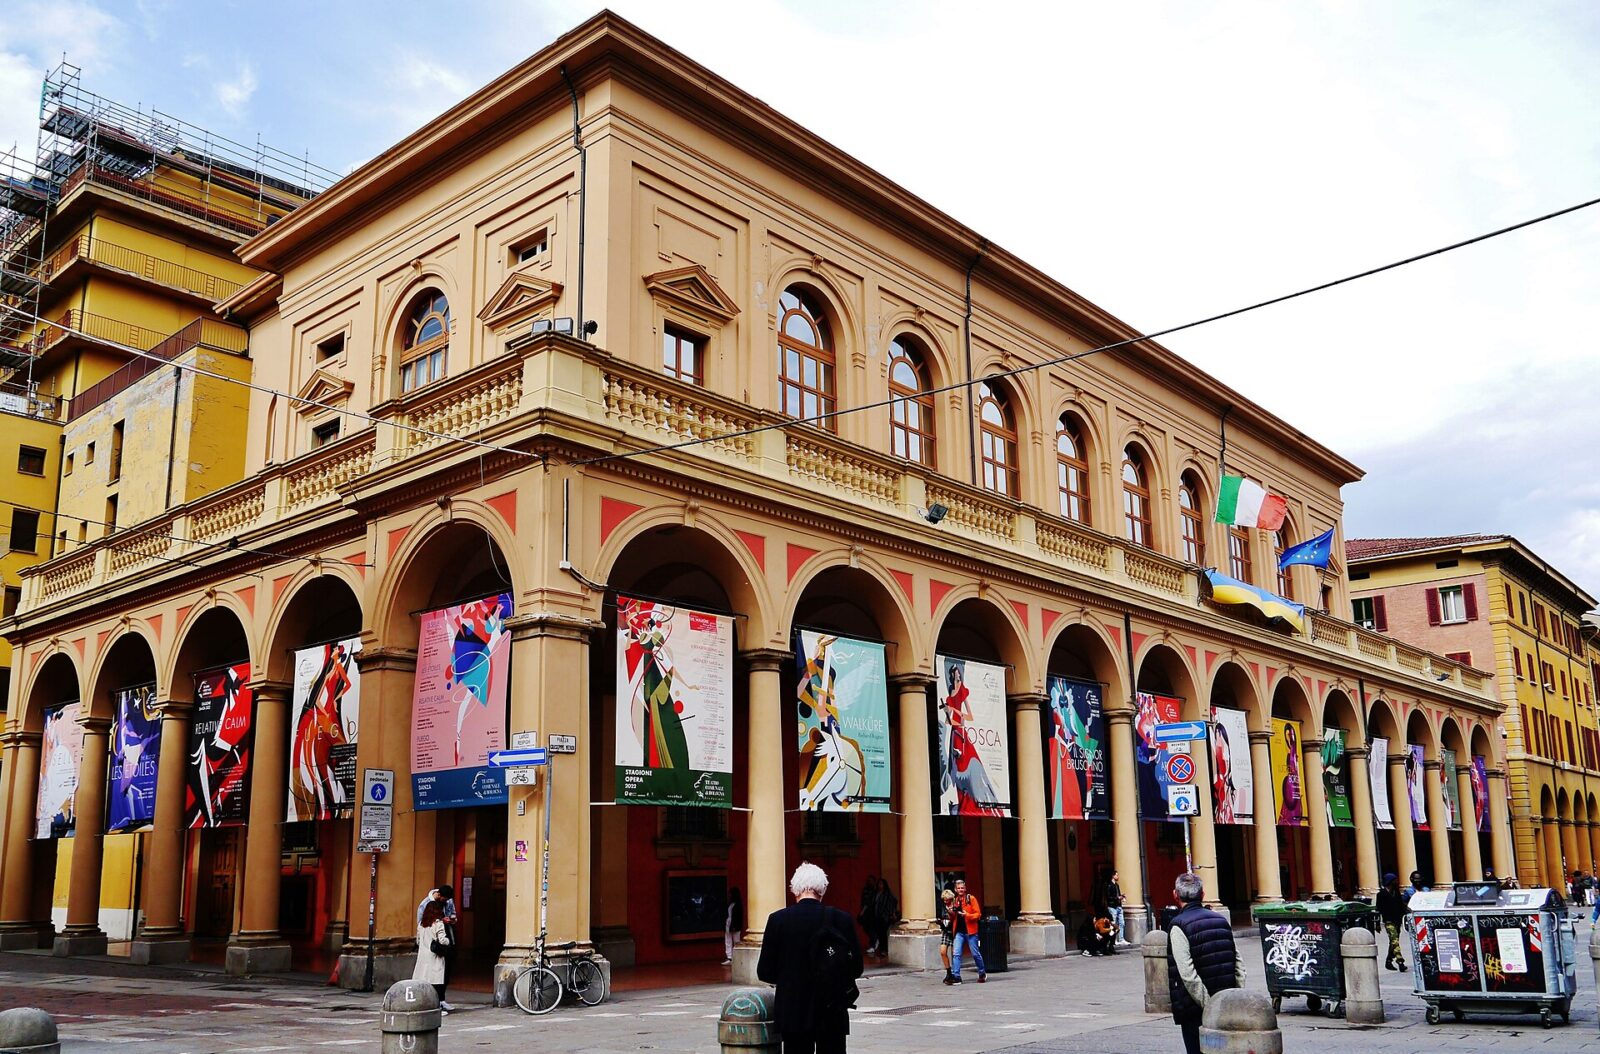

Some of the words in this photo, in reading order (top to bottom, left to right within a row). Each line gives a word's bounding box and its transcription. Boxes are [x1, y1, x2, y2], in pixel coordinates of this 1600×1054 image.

[195, 720, 220, 735] RELATIV
[225, 715, 246, 730] CALM
[964, 726, 1002, 748] OSCA
[111, 765, 123, 780] LES
[625, 768, 653, 777] STAGIONE
[1066, 758, 1104, 773] BRUSCNO
